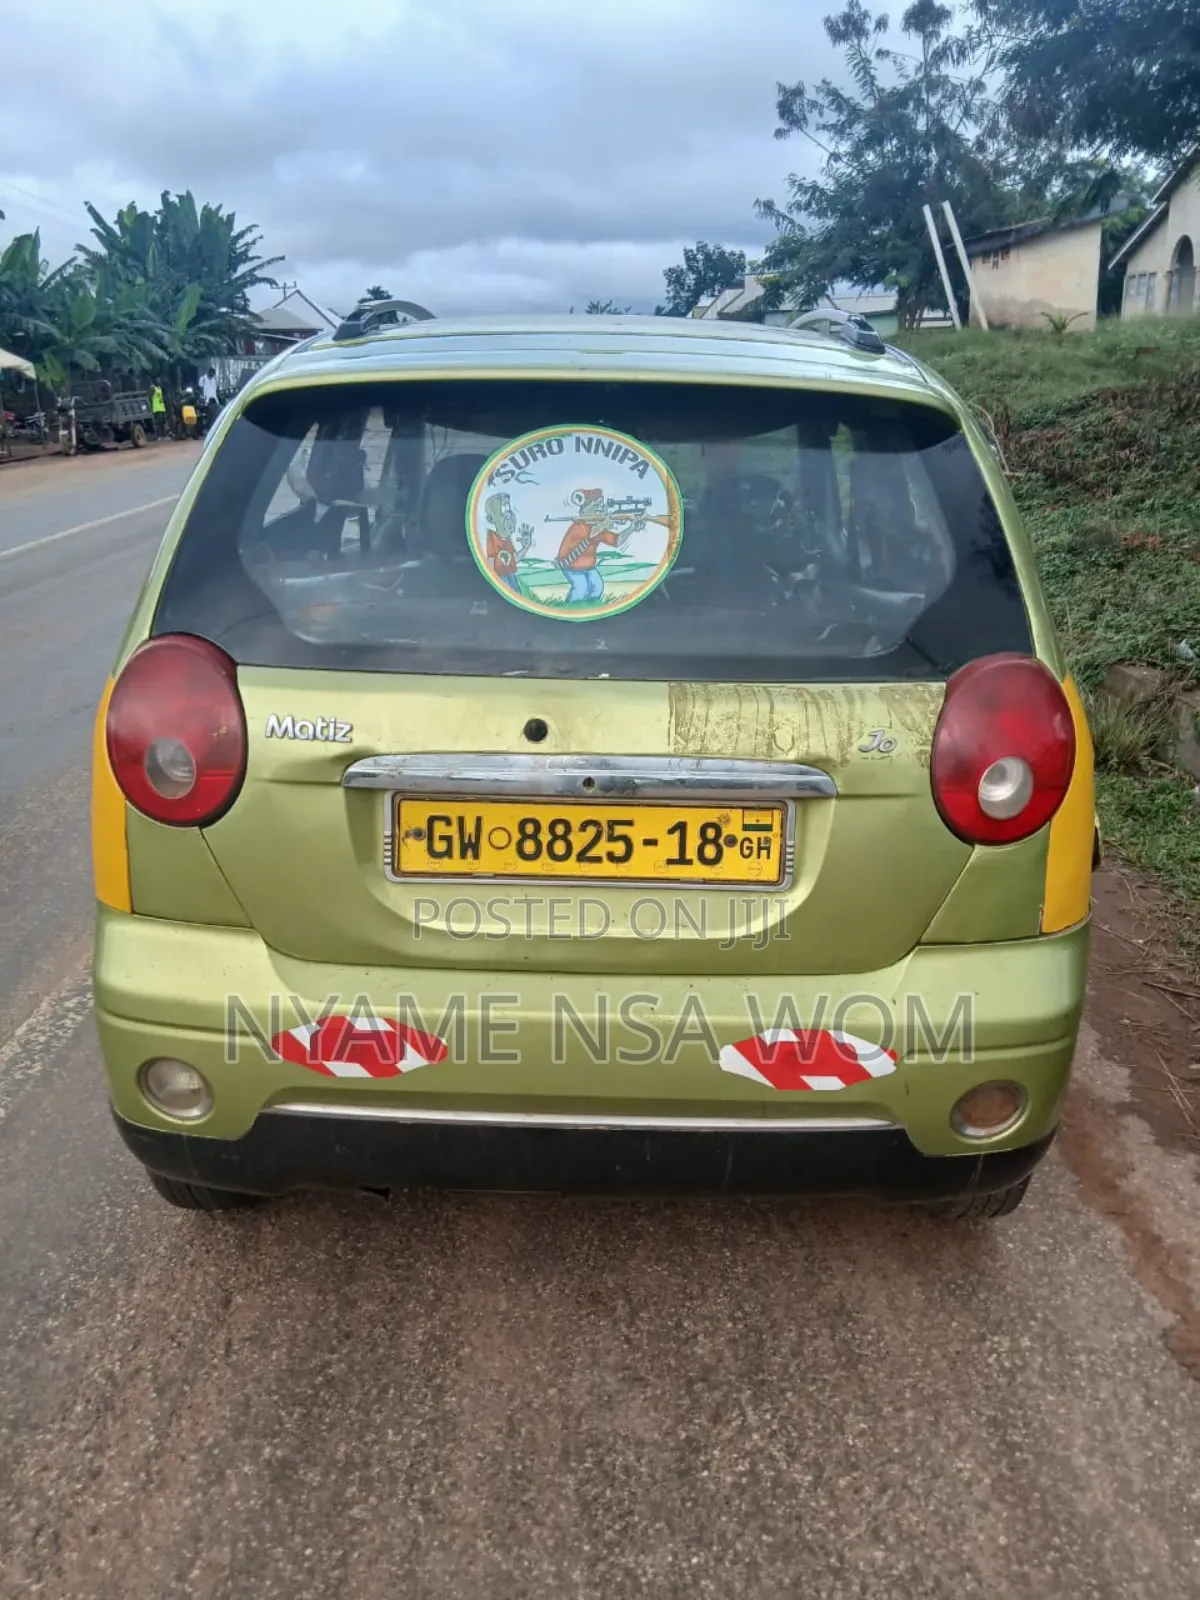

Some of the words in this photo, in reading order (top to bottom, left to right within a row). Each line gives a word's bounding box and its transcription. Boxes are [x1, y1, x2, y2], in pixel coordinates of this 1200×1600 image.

[575, 436, 651, 479] NNIPA
[265, 713, 353, 743] Matiz
[427, 815, 482, 860] GW
[516, 818, 724, 866] 8825-18
[739, 836, 772, 860] GH
